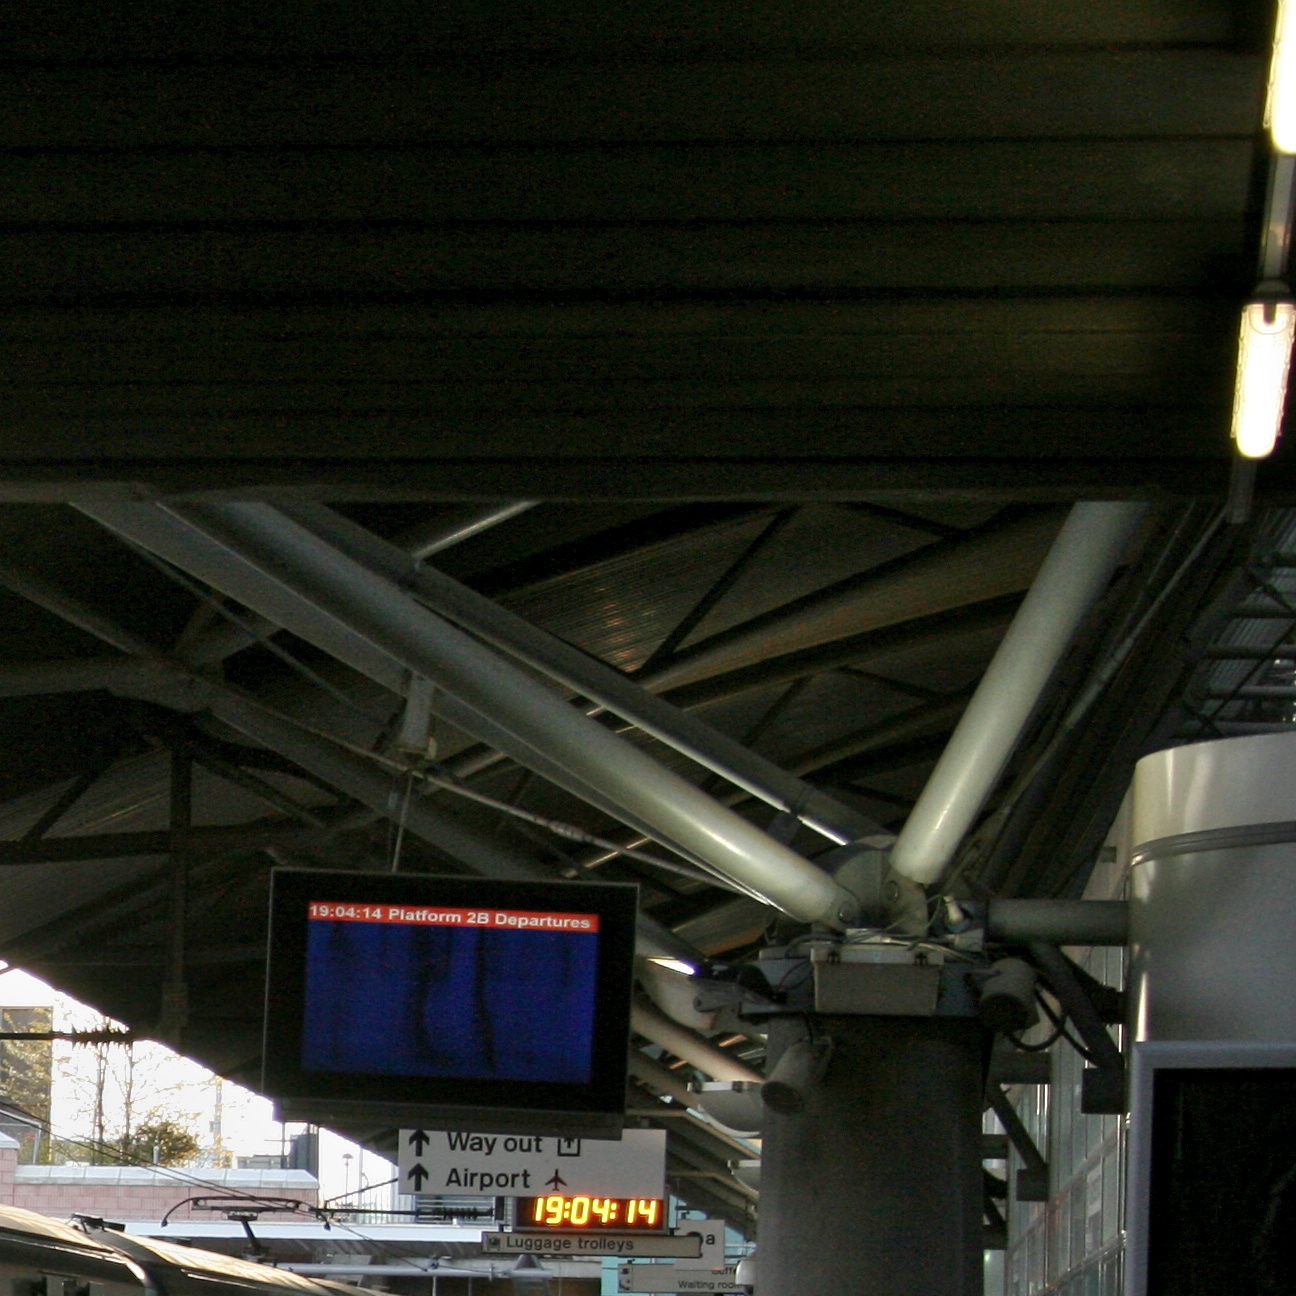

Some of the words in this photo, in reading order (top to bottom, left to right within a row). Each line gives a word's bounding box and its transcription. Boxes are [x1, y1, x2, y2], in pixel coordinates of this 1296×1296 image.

[309, 904, 383, 919] 19:04:14
[388, 907, 462, 925] Platform
[466, 911, 490, 925] 2B
[494, 912, 591, 931] Departures
[447, 1132, 498, 1155] Way
[503, 1136, 543, 1153] out
[445, 1168, 531, 1192] Airport
[506, 1235, 572, 1254] Luggage
[578, 1236, 635, 1252] trolleys
